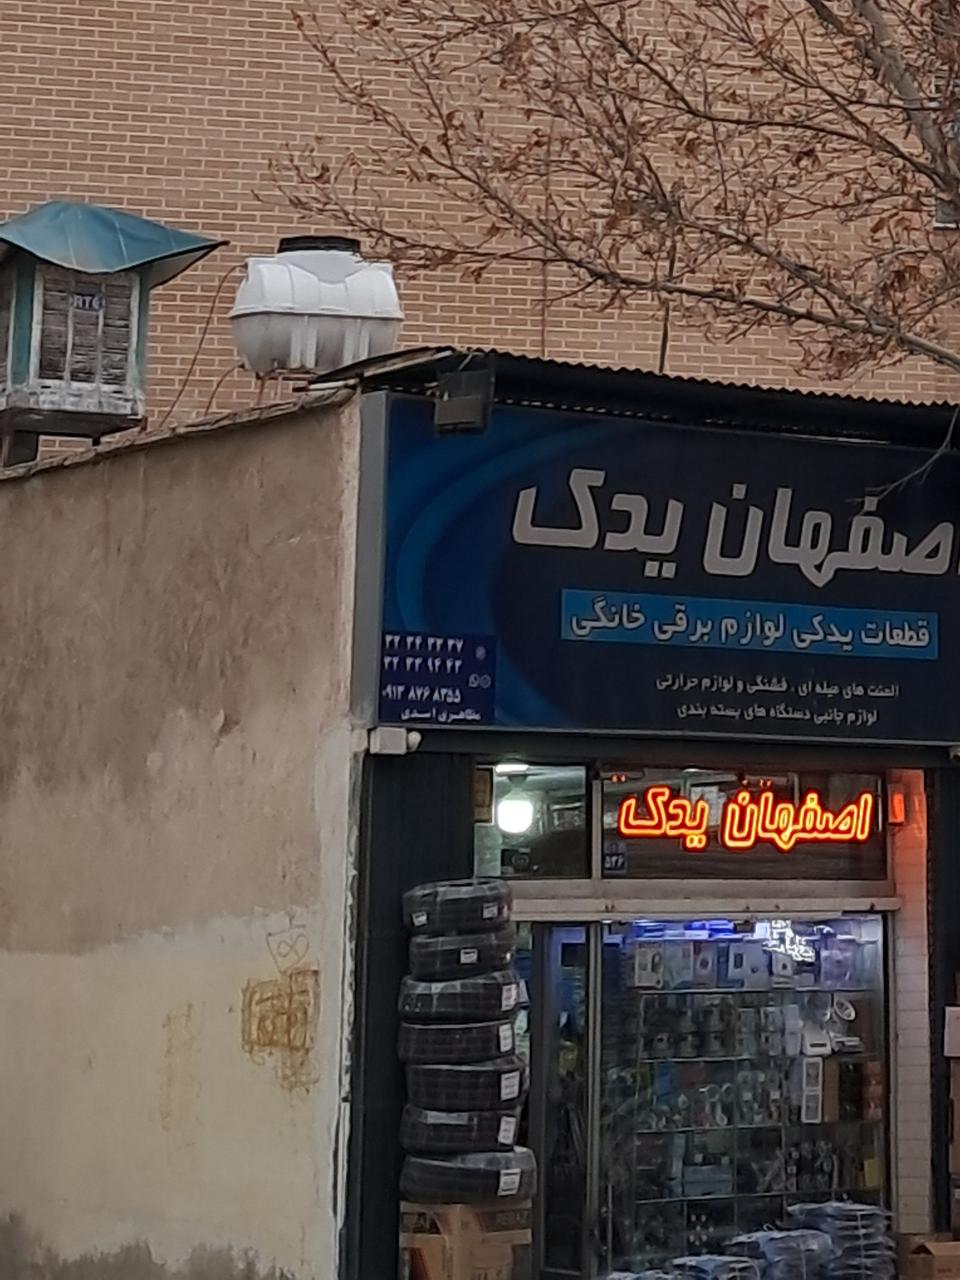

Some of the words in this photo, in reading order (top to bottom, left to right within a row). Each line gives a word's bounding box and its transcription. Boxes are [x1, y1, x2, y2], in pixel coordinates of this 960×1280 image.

[511, 467, 685, 580] یدک
[571, 596, 646, 637] خانگی
[652, 604, 713, 642] برقی
[720, 612, 785, 647] لوازم
[792, 615, 853, 653] یدکی
[860, 619, 931, 648] قطعات
[655, 673, 699, 691] حرارتی
[700, 675, 734, 693] لوازم
[746, 675, 788, 695] فشنگی
[815, 681, 839, 697] میله
[842, 682, 864, 699] های
[677, 703, 707, 719] بندی
[710, 704, 741, 720] بسته
[743, 703, 767, 721] های
[769, 703, 811, 721] دستگاه
[813, 708, 843, 727] جانبی
[846, 709, 878, 727] لوازم
[617, 785, 710, 850] یدک
[722, 790, 874, 852] اصفهان
